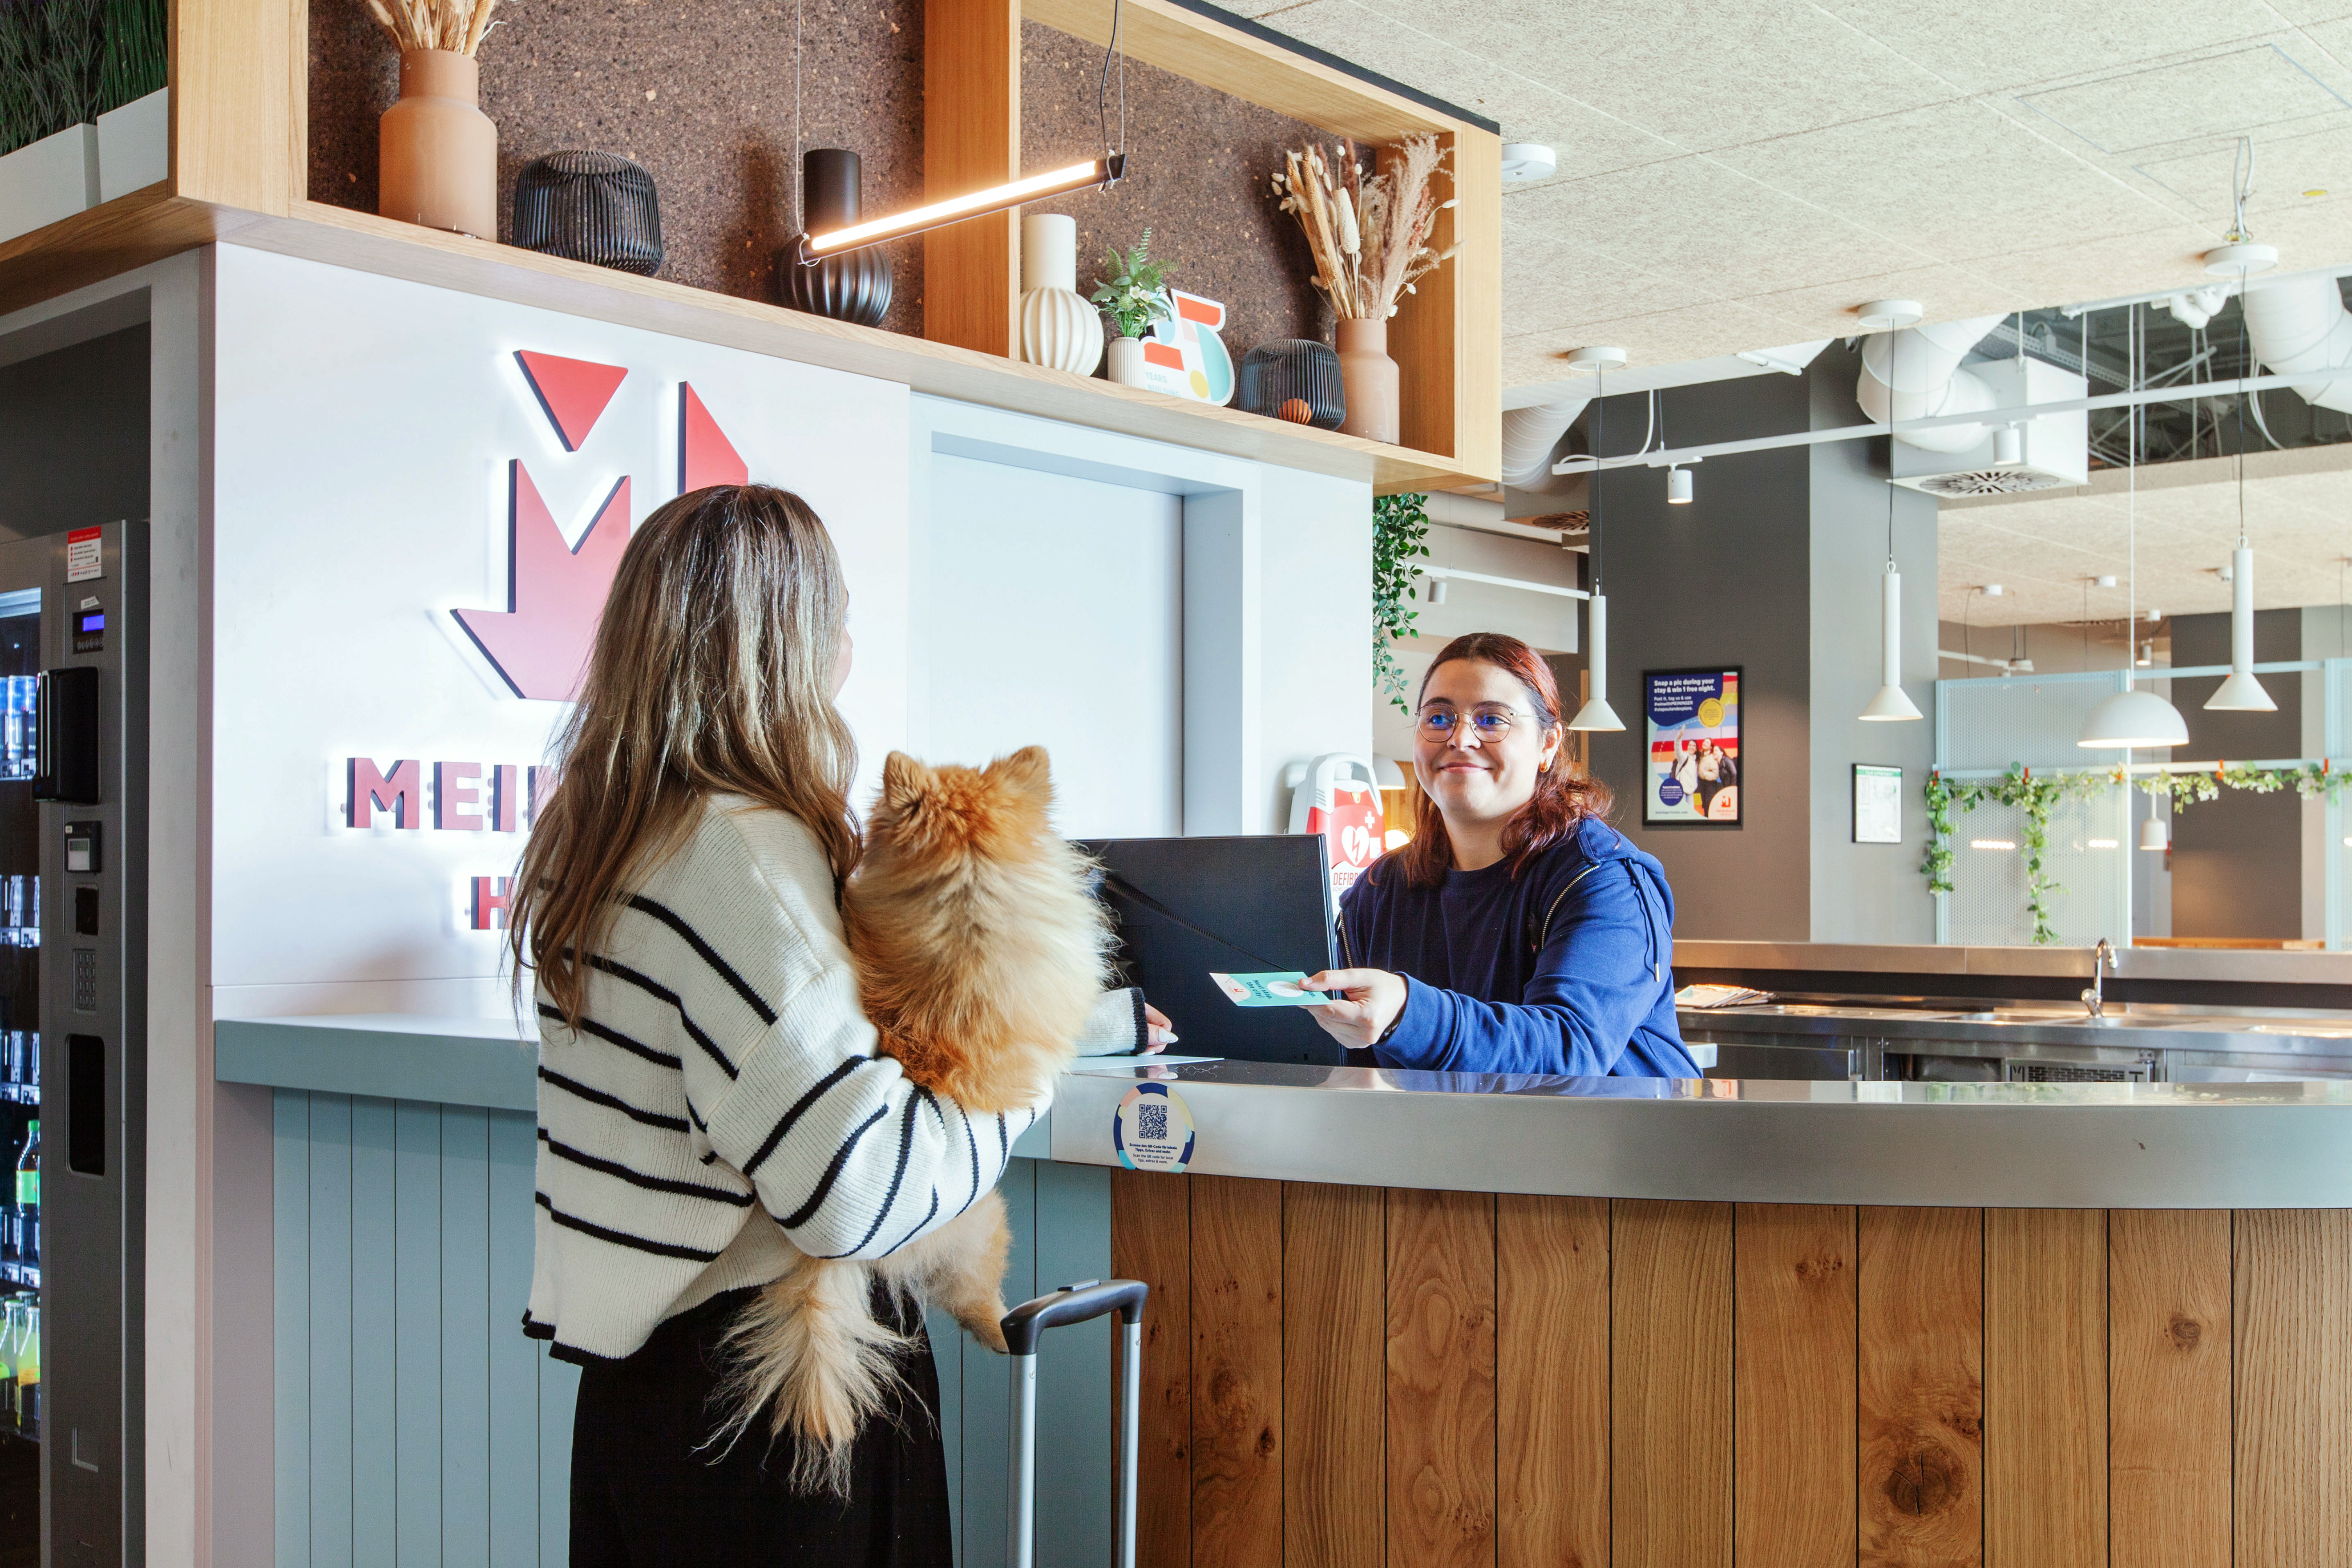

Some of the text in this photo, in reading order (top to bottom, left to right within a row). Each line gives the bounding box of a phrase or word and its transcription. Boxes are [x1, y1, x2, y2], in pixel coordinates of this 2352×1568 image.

[1145, 371, 1168, 383] YEARS
[1333, 872, 1359, 885] DEFIB
[1252, 980, 1265, 989] Next
